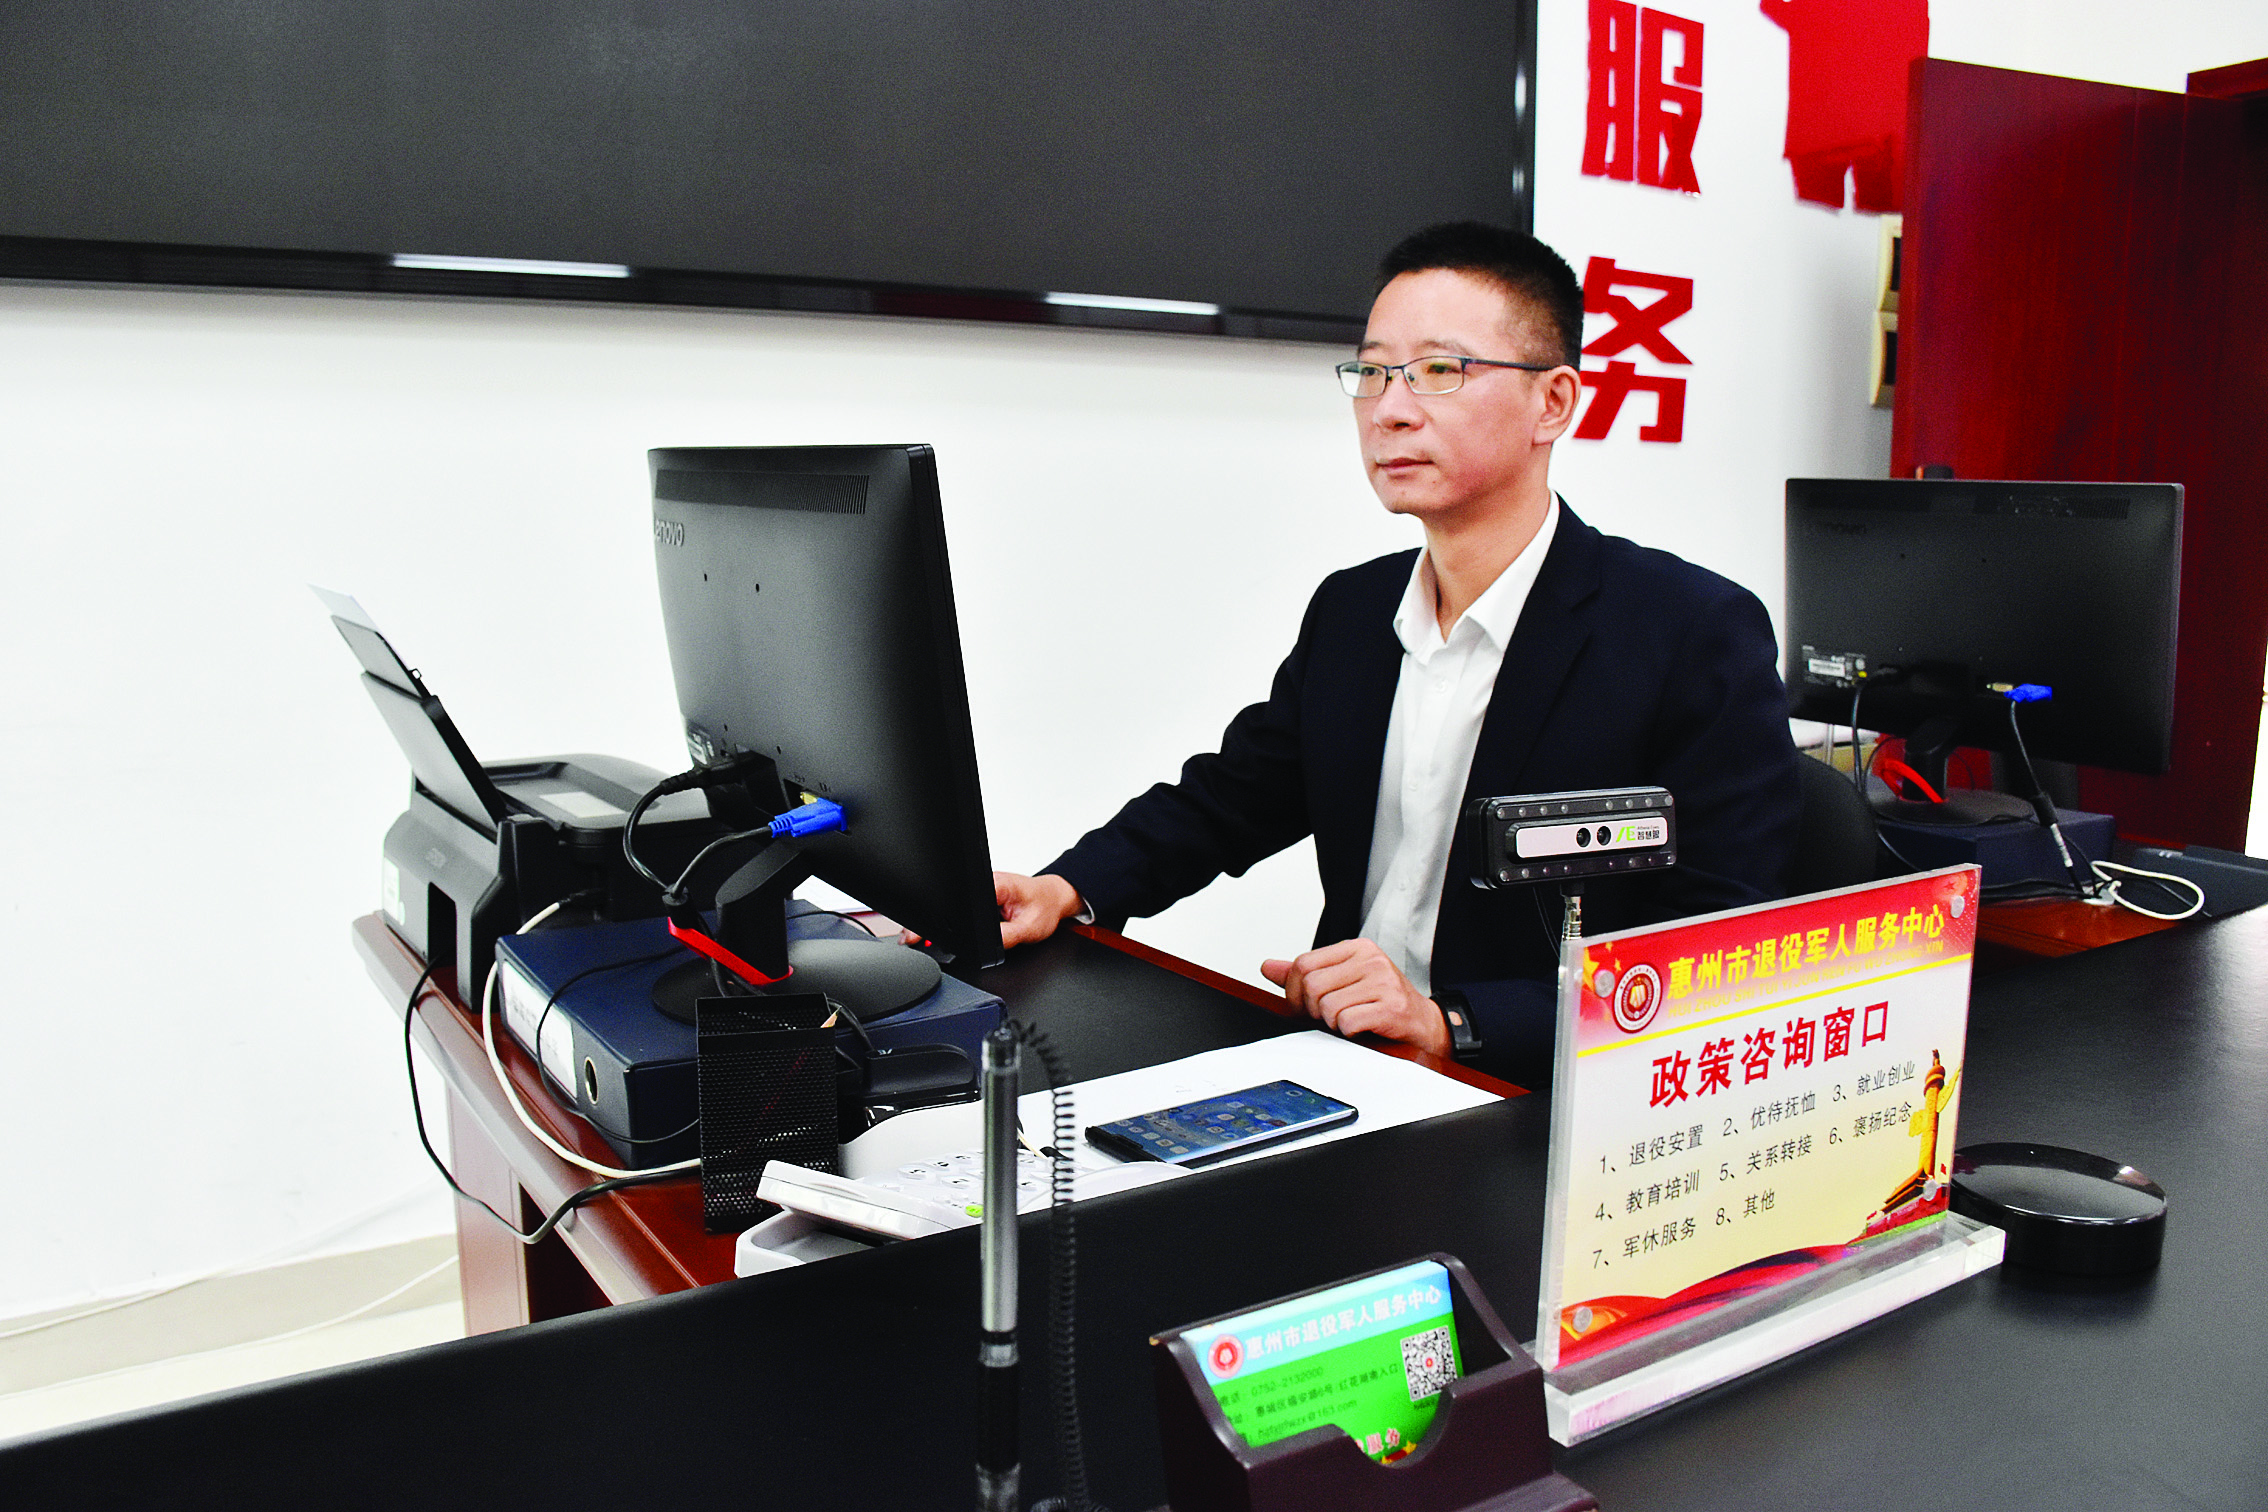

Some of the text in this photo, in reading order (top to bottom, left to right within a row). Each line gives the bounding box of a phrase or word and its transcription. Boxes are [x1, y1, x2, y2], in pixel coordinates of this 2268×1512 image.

[1573, 0, 1704, 443] 服务
[1667, 904, 1945, 1000] 惠州市退役军人服务中心
[1668, 1002, 1691, 1018] HUI
[1695, 992, 1731, 1012] ZHOU
[1734, 986, 1755, 1002] SHI
[1759, 980, 1779, 996] TUI
[1649, 1000, 1889, 1108] 政策咨询窗口
[1715, 1188, 1775, 1226] 8、其他
[1245, 1285, 1442, 1360] 惠州市退役军人服务中心
